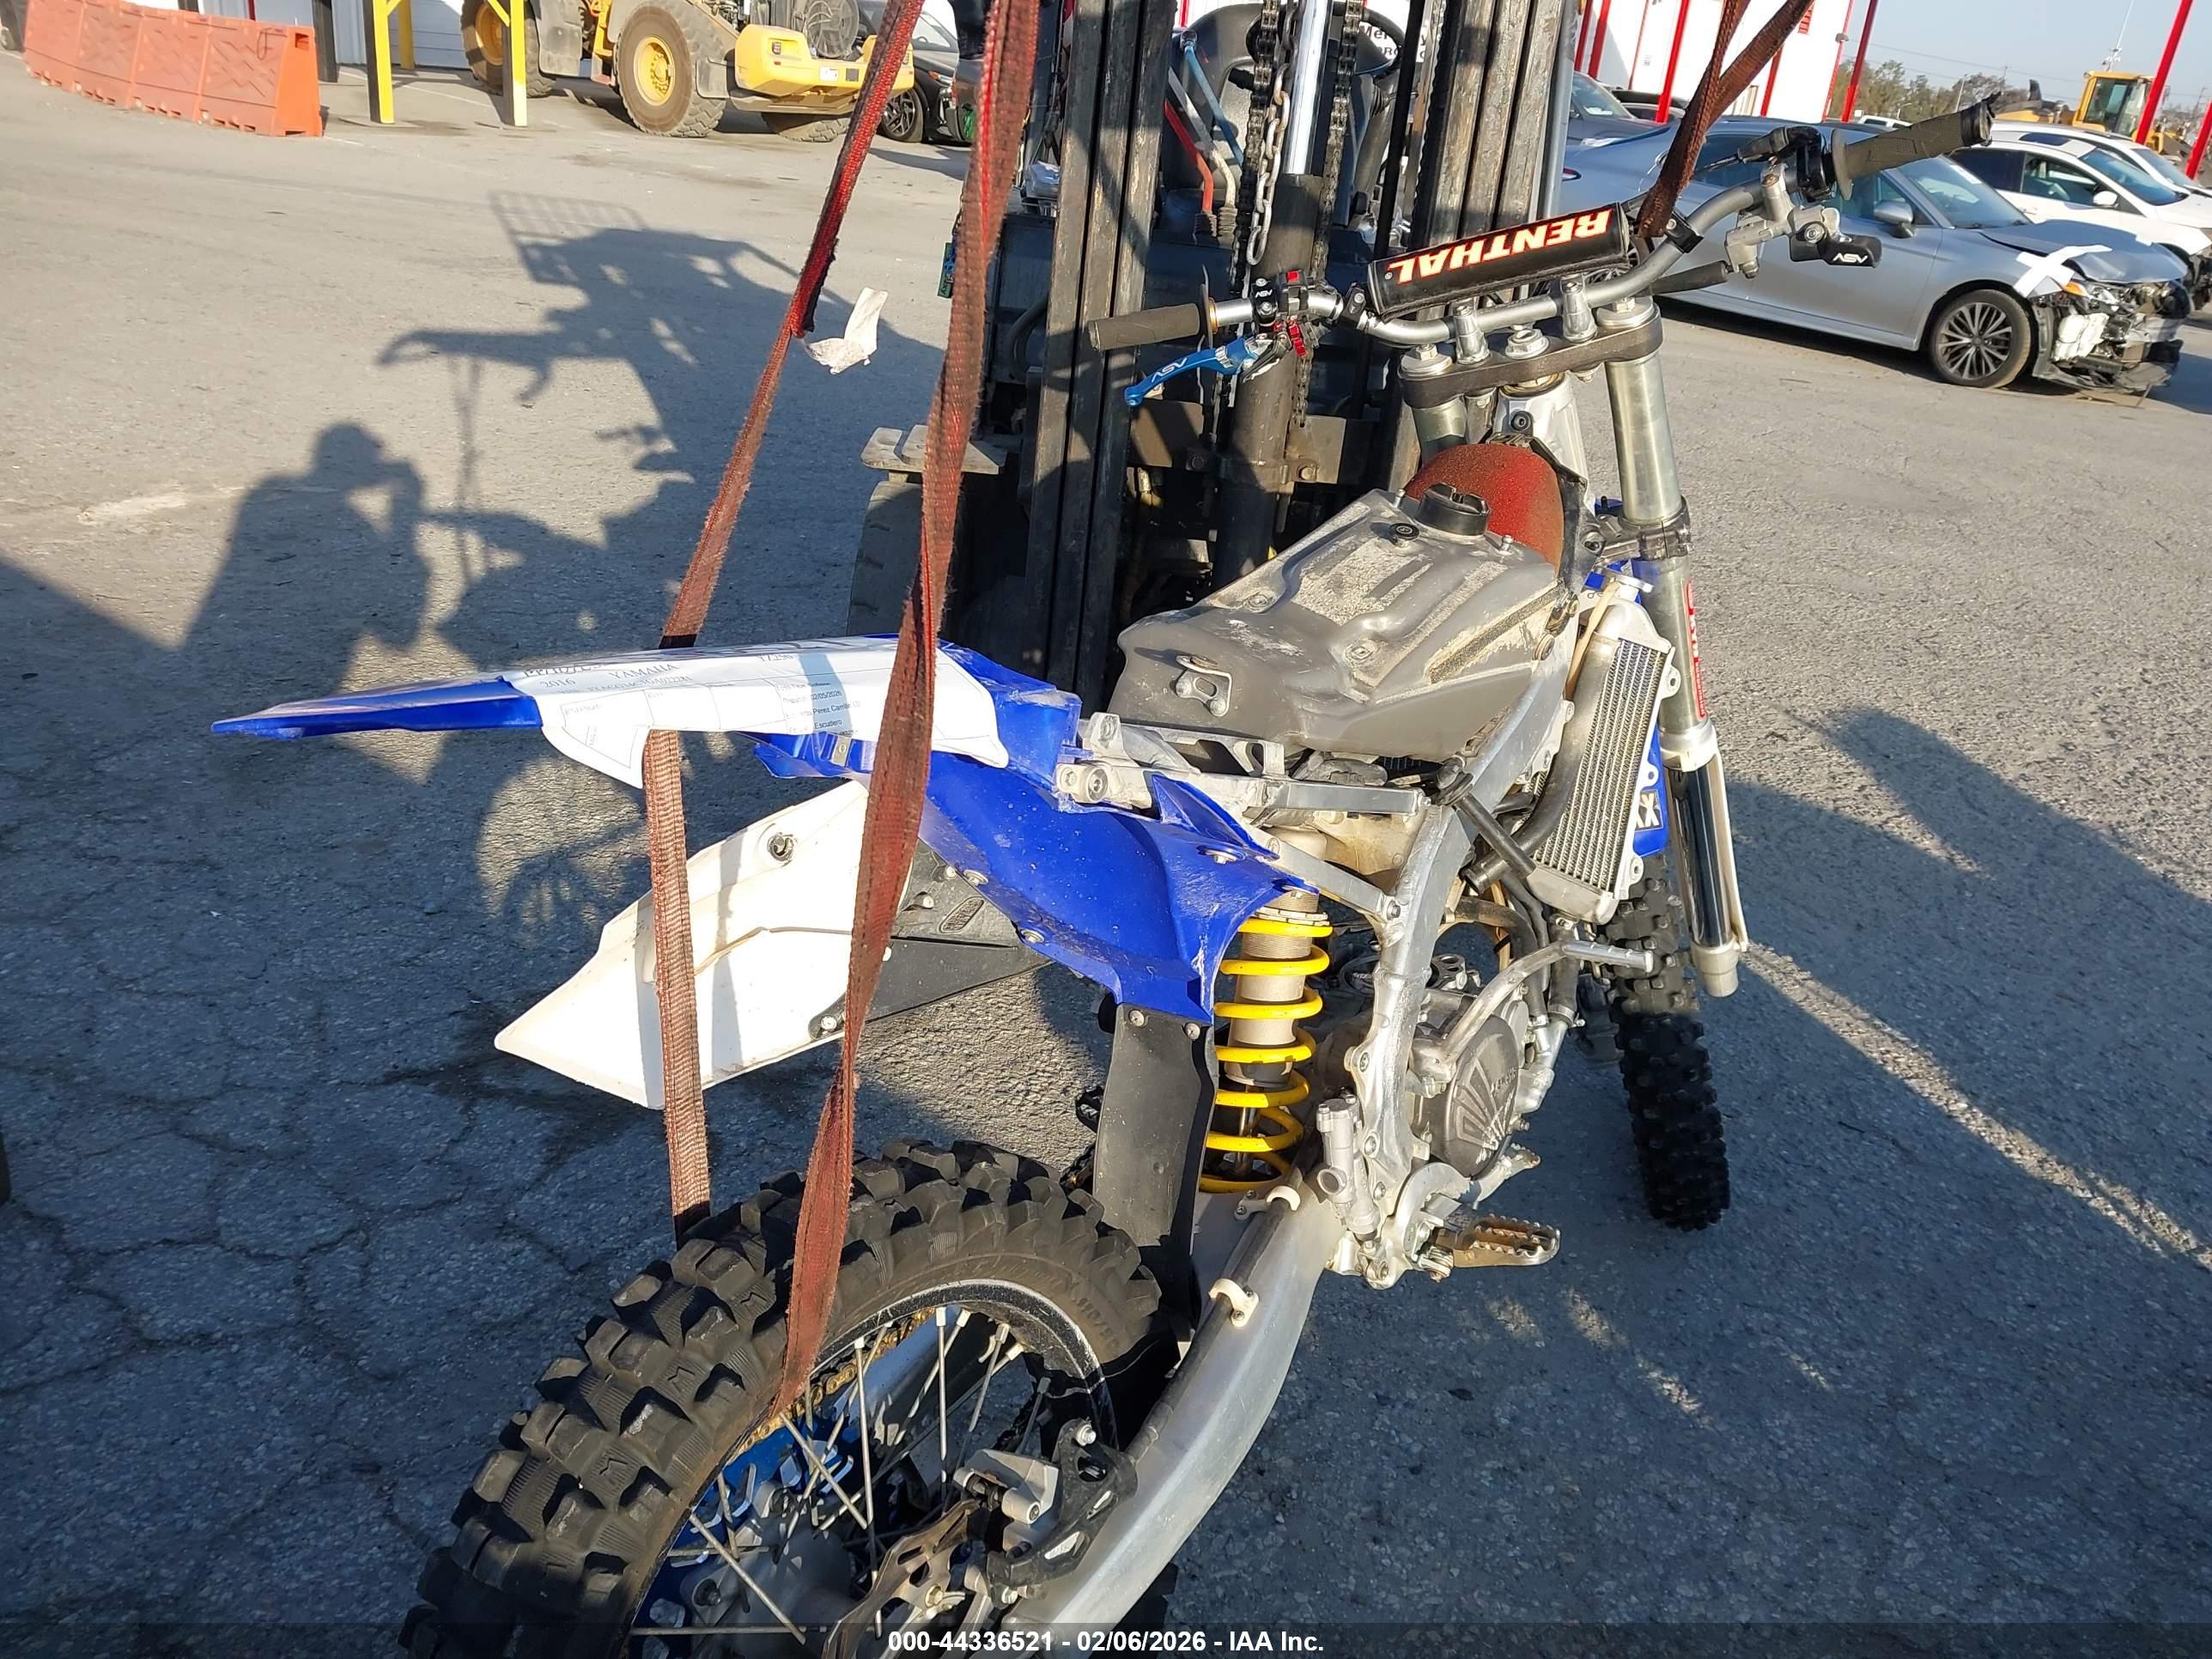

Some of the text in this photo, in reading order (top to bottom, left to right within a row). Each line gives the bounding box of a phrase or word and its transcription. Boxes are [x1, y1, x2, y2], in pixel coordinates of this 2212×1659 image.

[1388, 208, 1613, 284] RENTHAL
[1832, 252, 1869, 264] ASV
[1255, 289, 1273, 298] ASV
[1152, 357, 1188, 384] ASV
[609, 663, 679, 679] YAMAHA
[540, 678, 577, 689] 2016
[814, 719, 842, 729] Escudero
